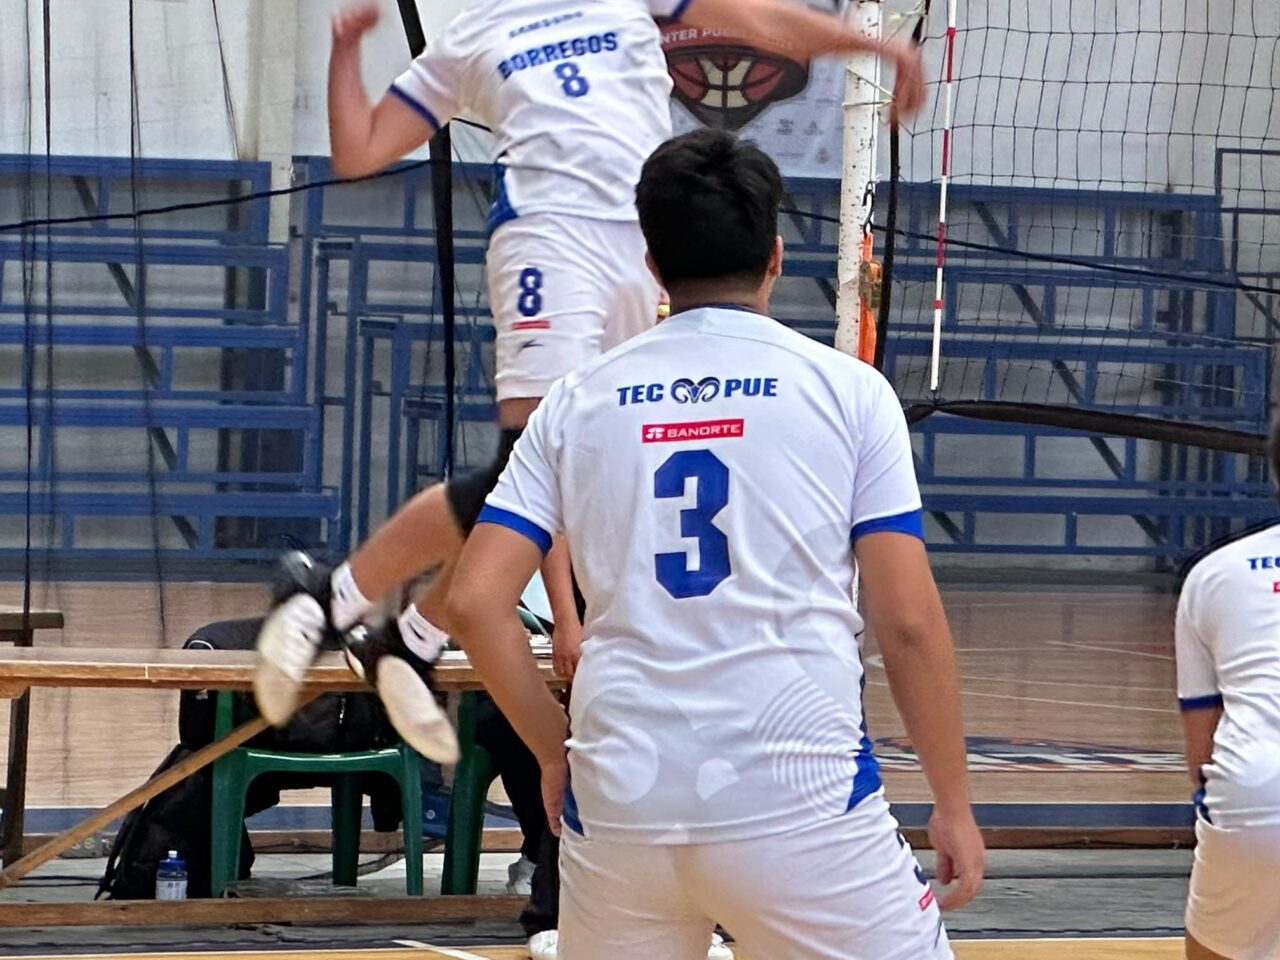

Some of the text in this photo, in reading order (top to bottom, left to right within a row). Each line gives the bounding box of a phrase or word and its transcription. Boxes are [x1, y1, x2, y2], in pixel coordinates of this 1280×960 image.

[661, 28, 698, 44] NTER
[554, 62, 590, 98] 8
[517, 267, 544, 318] 8
[616, 377, 778, 407] TEC PUE
[667, 424, 741, 439] BANORTE
[654, 448, 732, 599] 3
